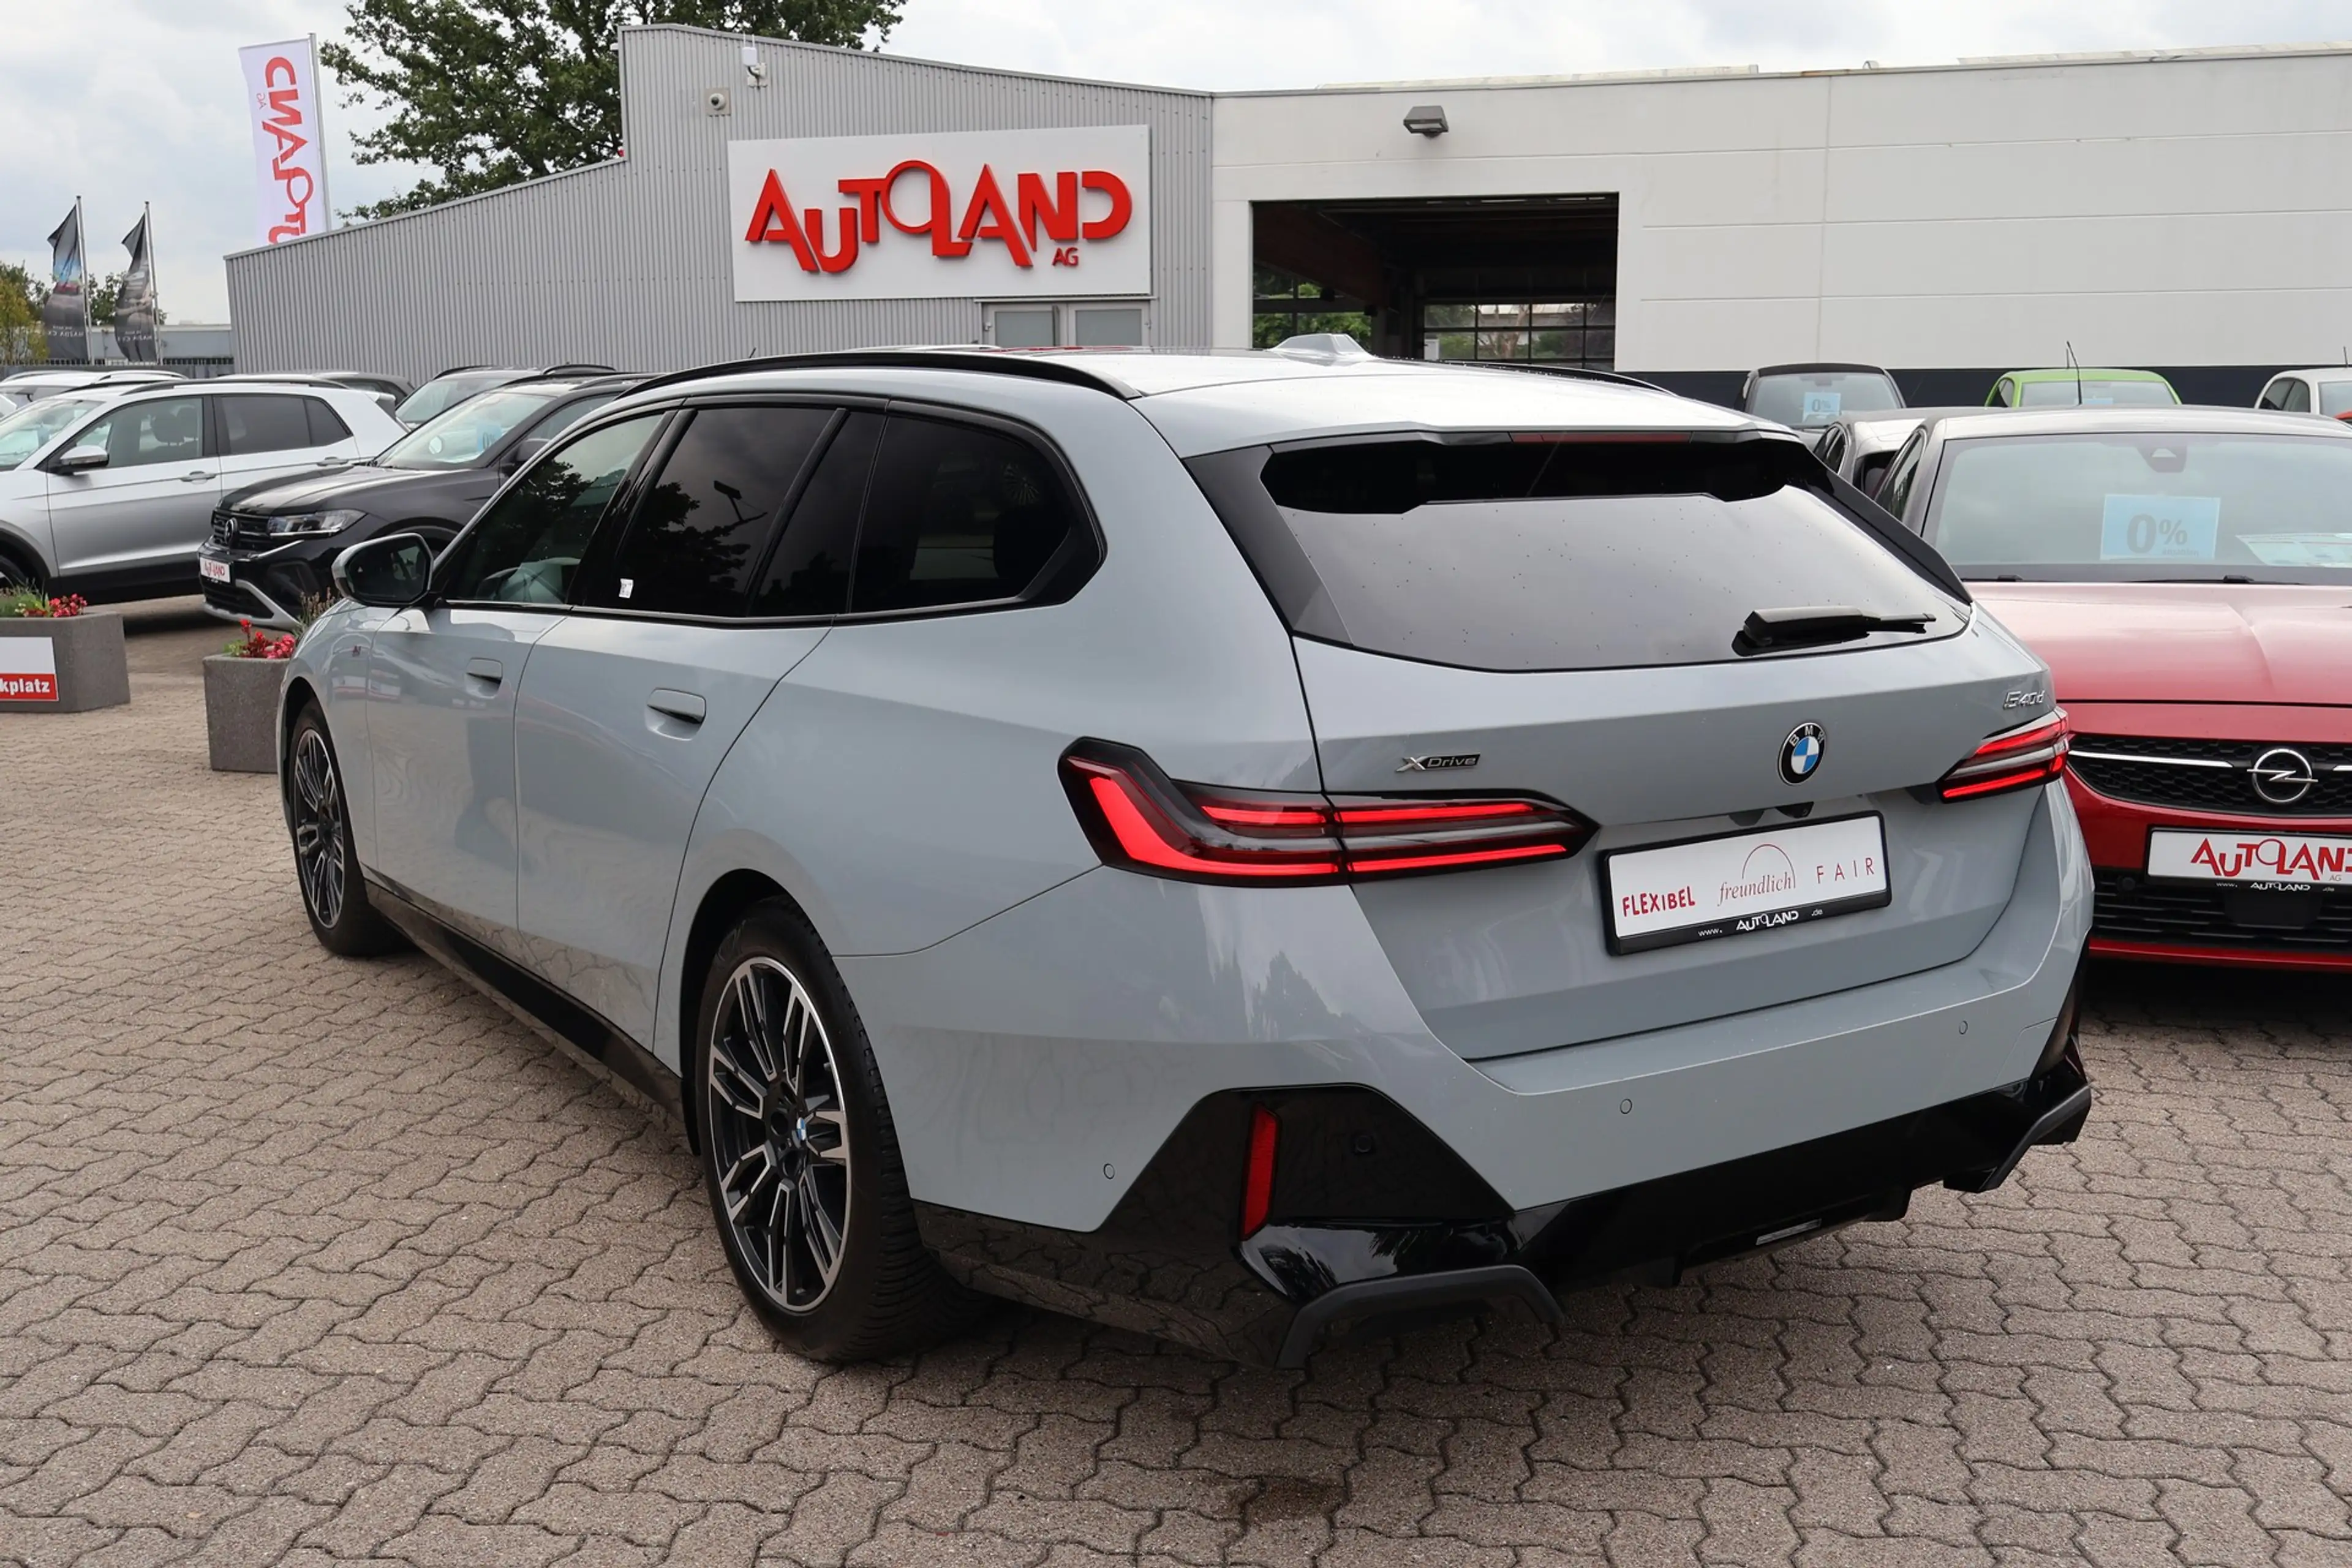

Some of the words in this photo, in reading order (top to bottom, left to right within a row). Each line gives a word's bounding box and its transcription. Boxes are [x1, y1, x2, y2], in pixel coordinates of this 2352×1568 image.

[745, 159, 1133, 274] AUTOLAND
[1052, 247, 1079, 267] AG
[2127, 513, 2188, 554] 0%
[2003, 690, 2045, 709] 540d
[1789, 725, 1825, 747] BMW
[1622, 886, 1695, 918] FLEXIBEL
[1717, 872, 1792, 907] freundlich
[1816, 857, 1875, 884] FAIR
[1811, 907, 1823, 918] .de
